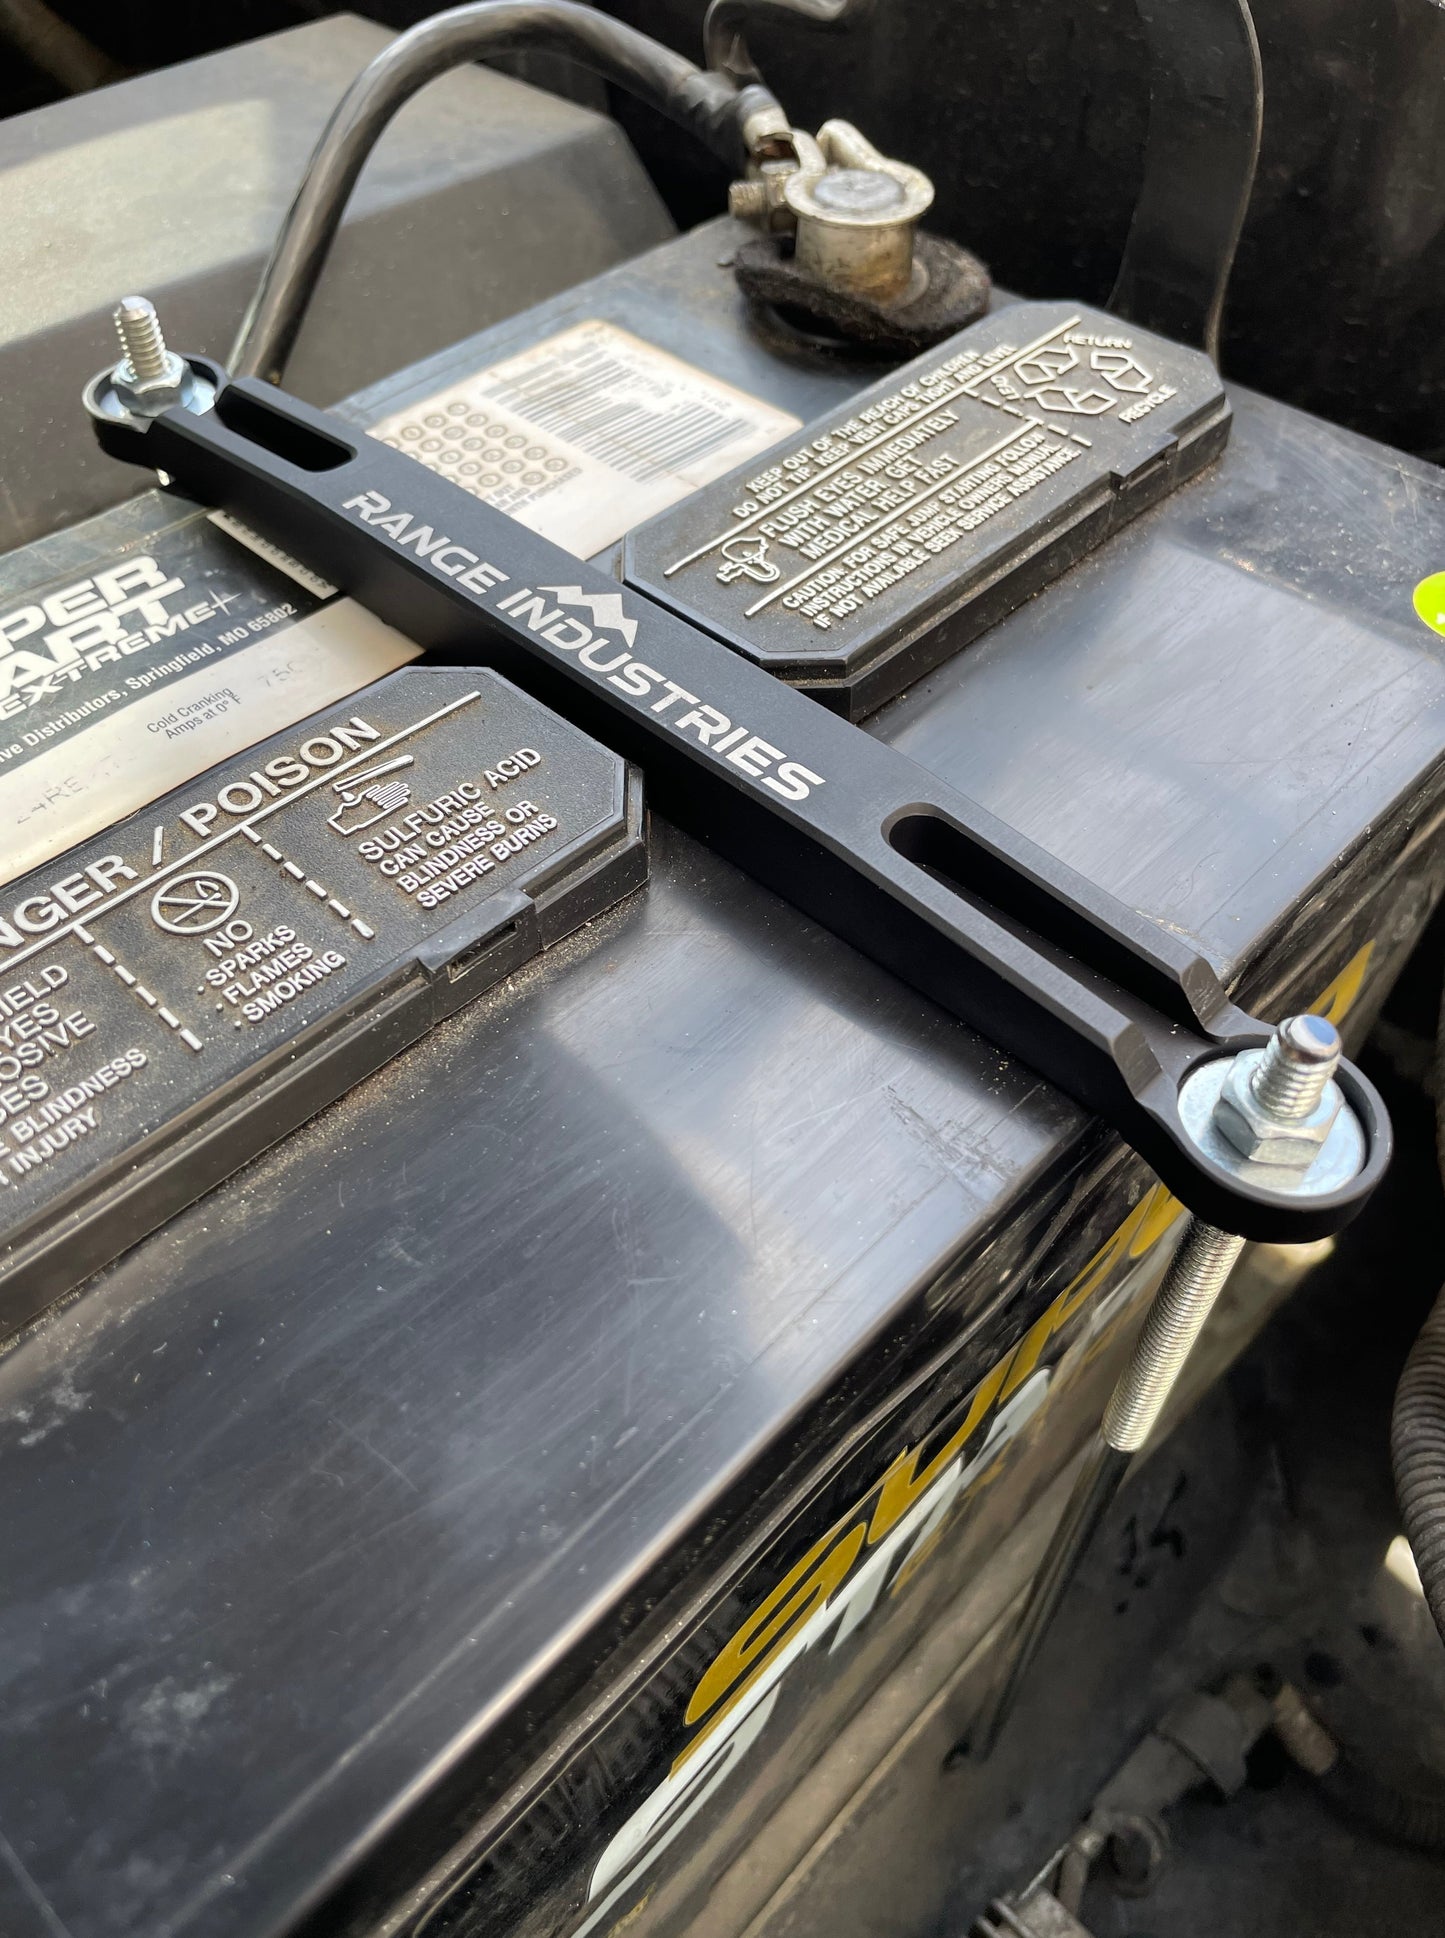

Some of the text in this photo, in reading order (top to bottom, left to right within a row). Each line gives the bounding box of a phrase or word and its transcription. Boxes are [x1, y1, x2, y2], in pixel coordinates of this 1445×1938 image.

[1063, 334, 1133, 349] RETURN
[733, 502, 760, 519] DO
[756, 480, 789, 504] NOT
[814, 443, 850, 467] KEEP
[849, 422, 888, 446] VENT
[883, 400, 922, 425] CAPS
[915, 379, 956, 404] TIGHT
[953, 363, 983, 384] AND
[746, 350, 981, 493] KEEP OUT OF THE REACH OF CHILDREN
[1118, 384, 1177, 424] RECYCLE
[759, 408, 959, 539] FLUSH EYES IMMEDIATELY
[778, 515, 831, 548] WITH
[885, 453, 923, 479] GET
[800, 452, 960, 560] MEDICAL HELP FAST
[842, 545, 877, 569] FOR
[871, 523, 911, 550] SAFE
[905, 500, 942, 528] JUMP
[938, 462, 1000, 504] STARTING
[995, 432, 1046, 468] FOLLOW
[342, 490, 511, 596] RANGE
[800, 551, 898, 617] INSTRUCTIONS
[891, 540, 914, 557] IN
[907, 506, 964, 543] VEHICLE
[958, 471, 1014, 510] OWNERS
[813, 612, 833, 630] IF
[829, 593, 864, 619] NOT
[861, 548, 931, 599] AVAILABLE
[924, 526, 964, 554] SEEK
[956, 493, 1014, 531] SERVICE
[0, 555, 168, 658] PER
[22, 688, 129, 747] Distributors,
[124, 641, 222, 691] Springfield,
[218, 626, 250, 647] MO
[247, 602, 298, 633] 65802
[147, 711, 179, 734] Cold
[176, 686, 236, 720] Cranking
[496, 587, 827, 802] INDUSTRIES
[165, 714, 204, 740] Amps
[203, 706, 219, 722] at
[152, 826, 164, 867] /
[179, 716, 381, 837] POISON
[358, 748, 541, 861] SULFURIC ACID
[379, 801, 496, 876] CAN CAUSE
[396, 799, 539, 893] BLINDNESS OR
[416, 813, 558, 908] SEVERE BURNS
[203, 920, 253, 957] NO
[205, 925, 296, 987] SPARKS
[222, 943, 313, 1005] FLAMES
[242, 950, 346, 1022] SMOKING
[0, 965, 68, 1021] IELD
[0, 1074, 49, 1126] ES
[9, 1106, 98, 1175] INJURY
[10, 1048, 148, 1144] BLINDNESS
